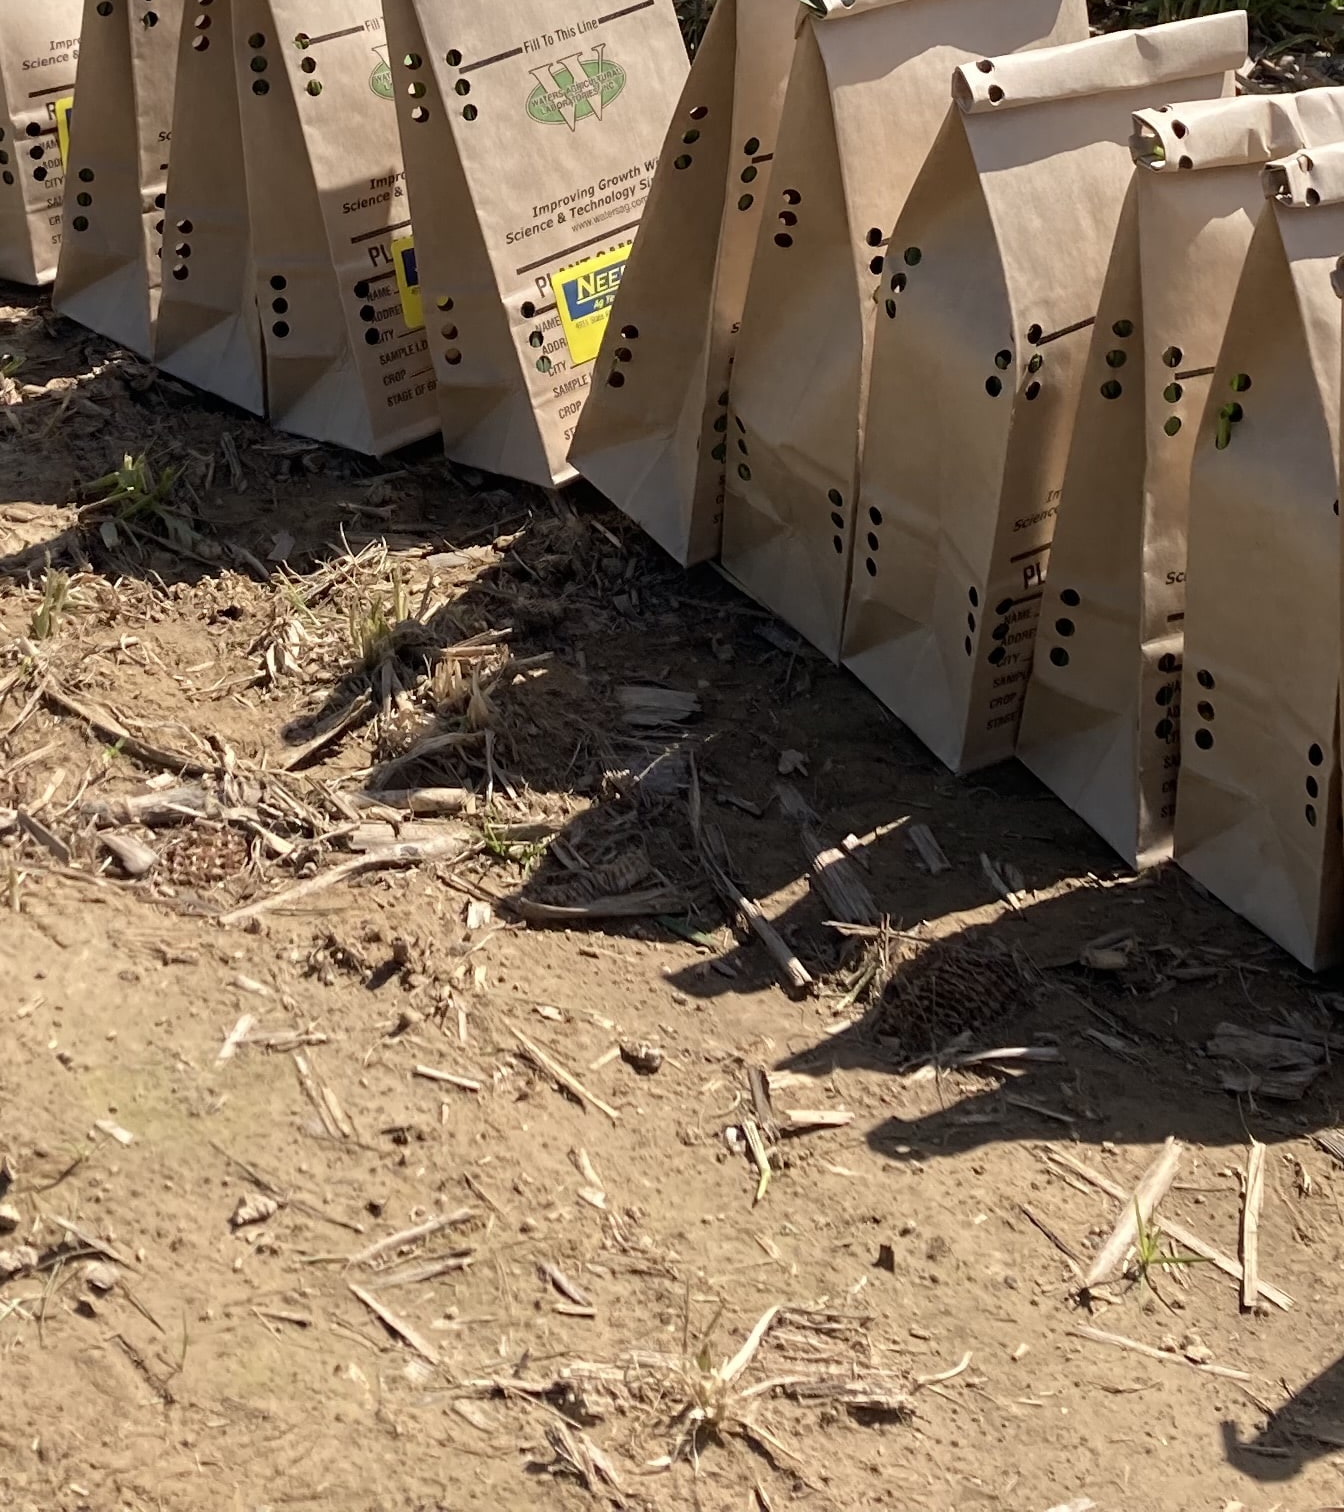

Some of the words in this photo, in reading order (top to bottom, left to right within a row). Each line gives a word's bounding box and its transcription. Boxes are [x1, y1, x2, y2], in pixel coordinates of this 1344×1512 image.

[365, 18, 380, 32] Fill
[524, 37, 540, 54] Fill
[541, 34, 554, 45] To
[554, 27, 576, 42] This
[577, 19, 598, 34] Line
[22, 53, 69, 70] Science
[532, 90, 564, 107] WATERS
[343, 192, 390, 214] Science
[395, 186, 403, 197] &
[532, 185, 595, 218] Improving
[598, 165, 641, 190] Growth
[506, 218, 554, 245] Science
[557, 212, 566, 224] &
[569, 185, 636, 219] Technology
[380, 344, 413, 365] SAMPLE
[383, 370, 406, 386] CROP
[547, 360, 567, 377] CITY
[552, 373, 589, 398] SAMPLE
[387, 389, 413, 407] STAGE
[558, 400, 582, 420] CROP
